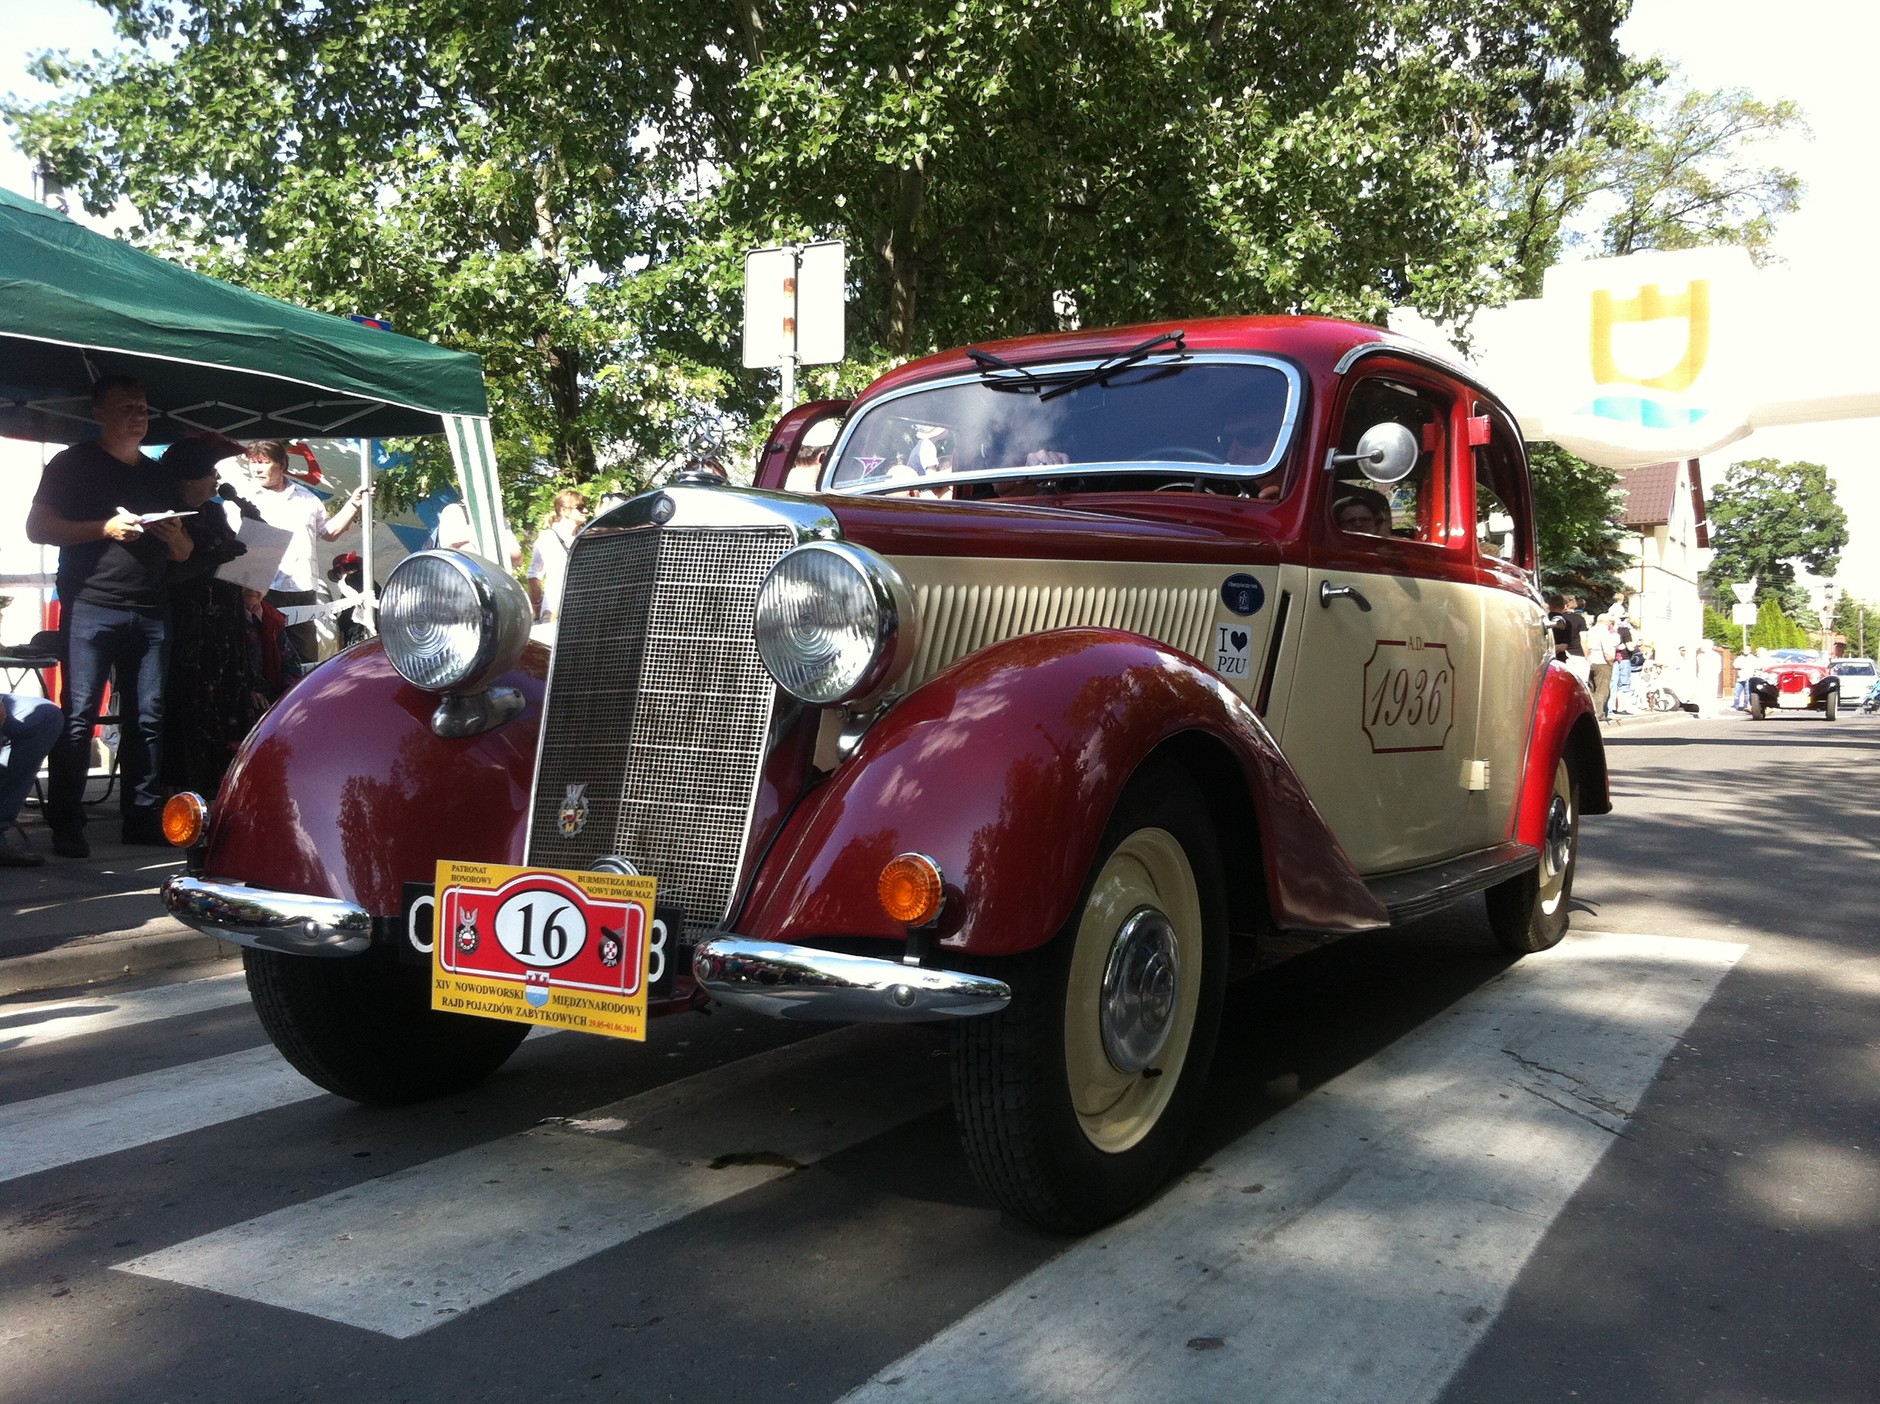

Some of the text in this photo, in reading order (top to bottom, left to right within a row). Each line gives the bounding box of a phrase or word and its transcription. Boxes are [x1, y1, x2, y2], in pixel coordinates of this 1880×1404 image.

[1218, 627, 1228, 653] I
[1408, 636, 1425, 651] A.D.
[1217, 655, 1247, 674] PZU
[1371, 668, 1448, 727] 1936
[451, 864, 488, 875] PATRONAT
[451, 874, 493, 885] HONOROWY
[577, 875, 654, 889] BURMISTRZA MIASTA
[587, 886, 653, 899] NOWY DWÓR MAZ.
[516, 902, 570, 959] 16
[435, 979, 643, 1017] XIV NOWODWORSKI MIĘDZYNARODOWY
[442, 996, 464, 1008] RAJD
[466, 1000, 513, 1016] POJAZDÓW
[516, 1006, 587, 1026] ZABYTKOWYCH
